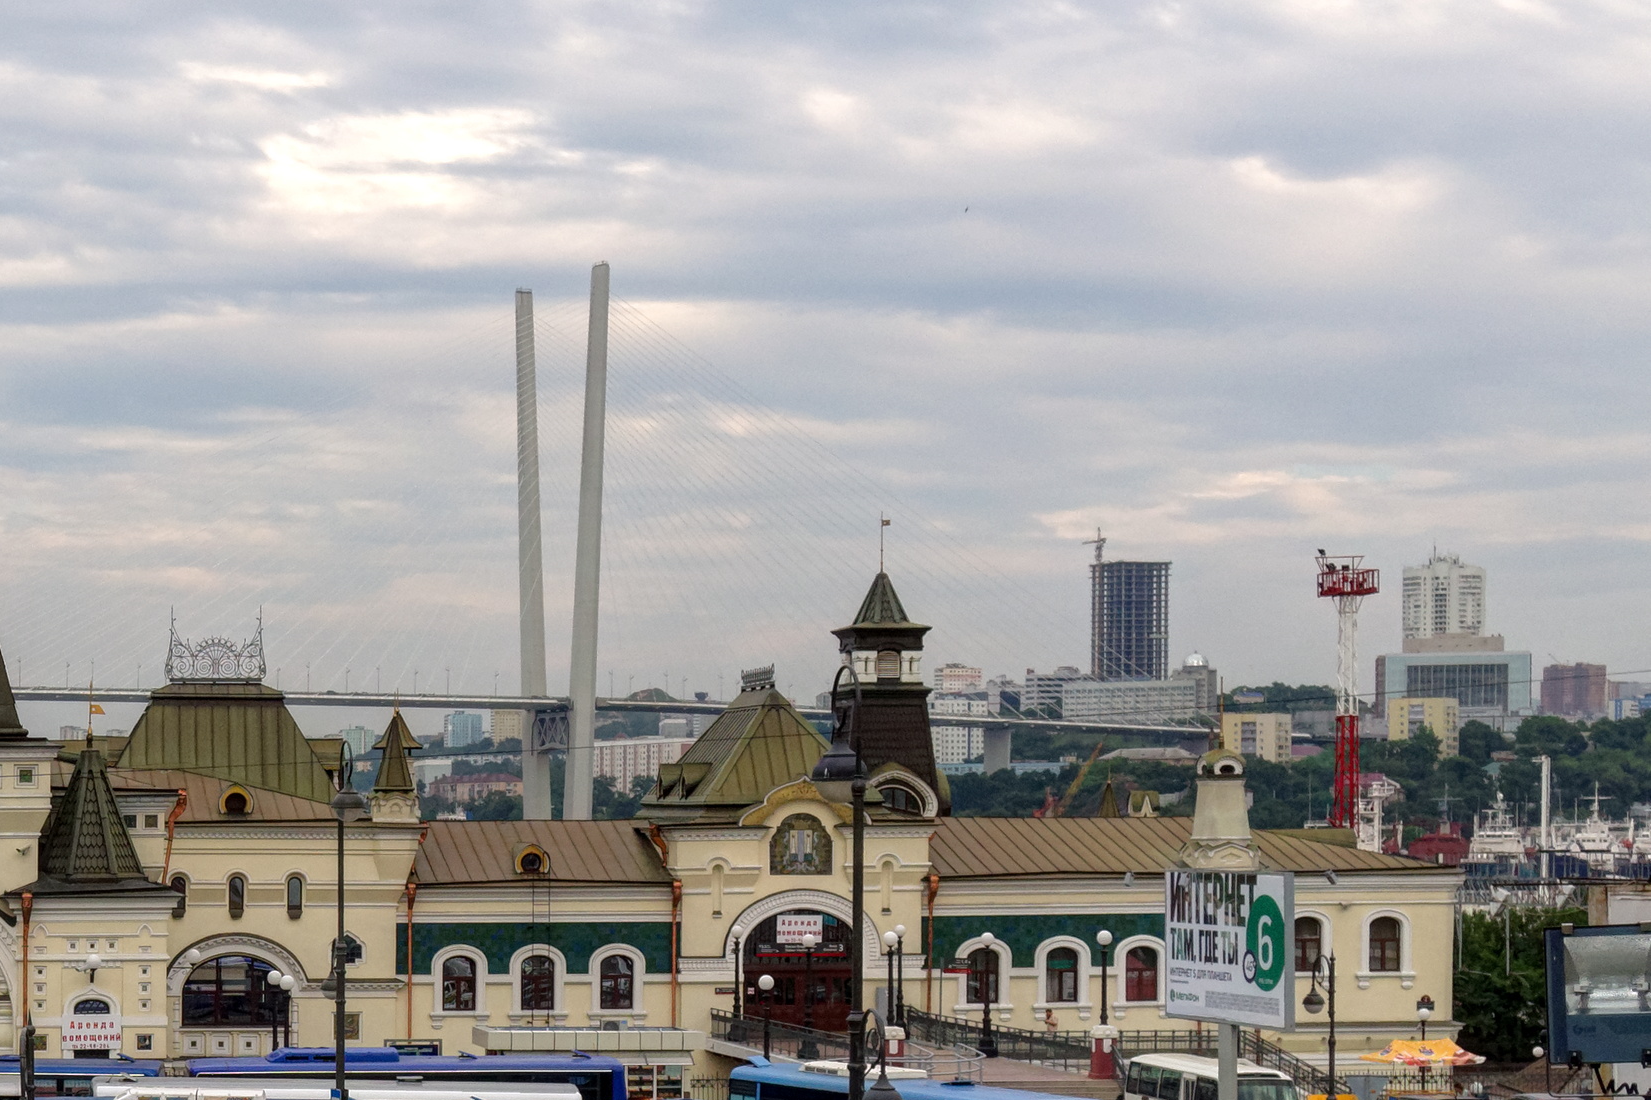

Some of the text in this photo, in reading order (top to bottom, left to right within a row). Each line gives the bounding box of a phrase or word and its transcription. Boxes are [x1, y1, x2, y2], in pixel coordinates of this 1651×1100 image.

[1170, 872, 1257, 927] ИНТЕРНЕТ
[838, 944, 844, 952] 3
[1170, 927, 1239, 966] ТАМ, ГДЕ ТЫ
[1257, 914, 1274, 971] 6
[1170, 967, 1193, 978] ИНТЕРНЕТ
[1197, 970, 1207, 979] ДЛЯ
[1207, 971, 1232, 982] ПЛАНШЕТА
[70, 1021, 114, 1029] Аренда
[62, 1033, 121, 1042] помещений
